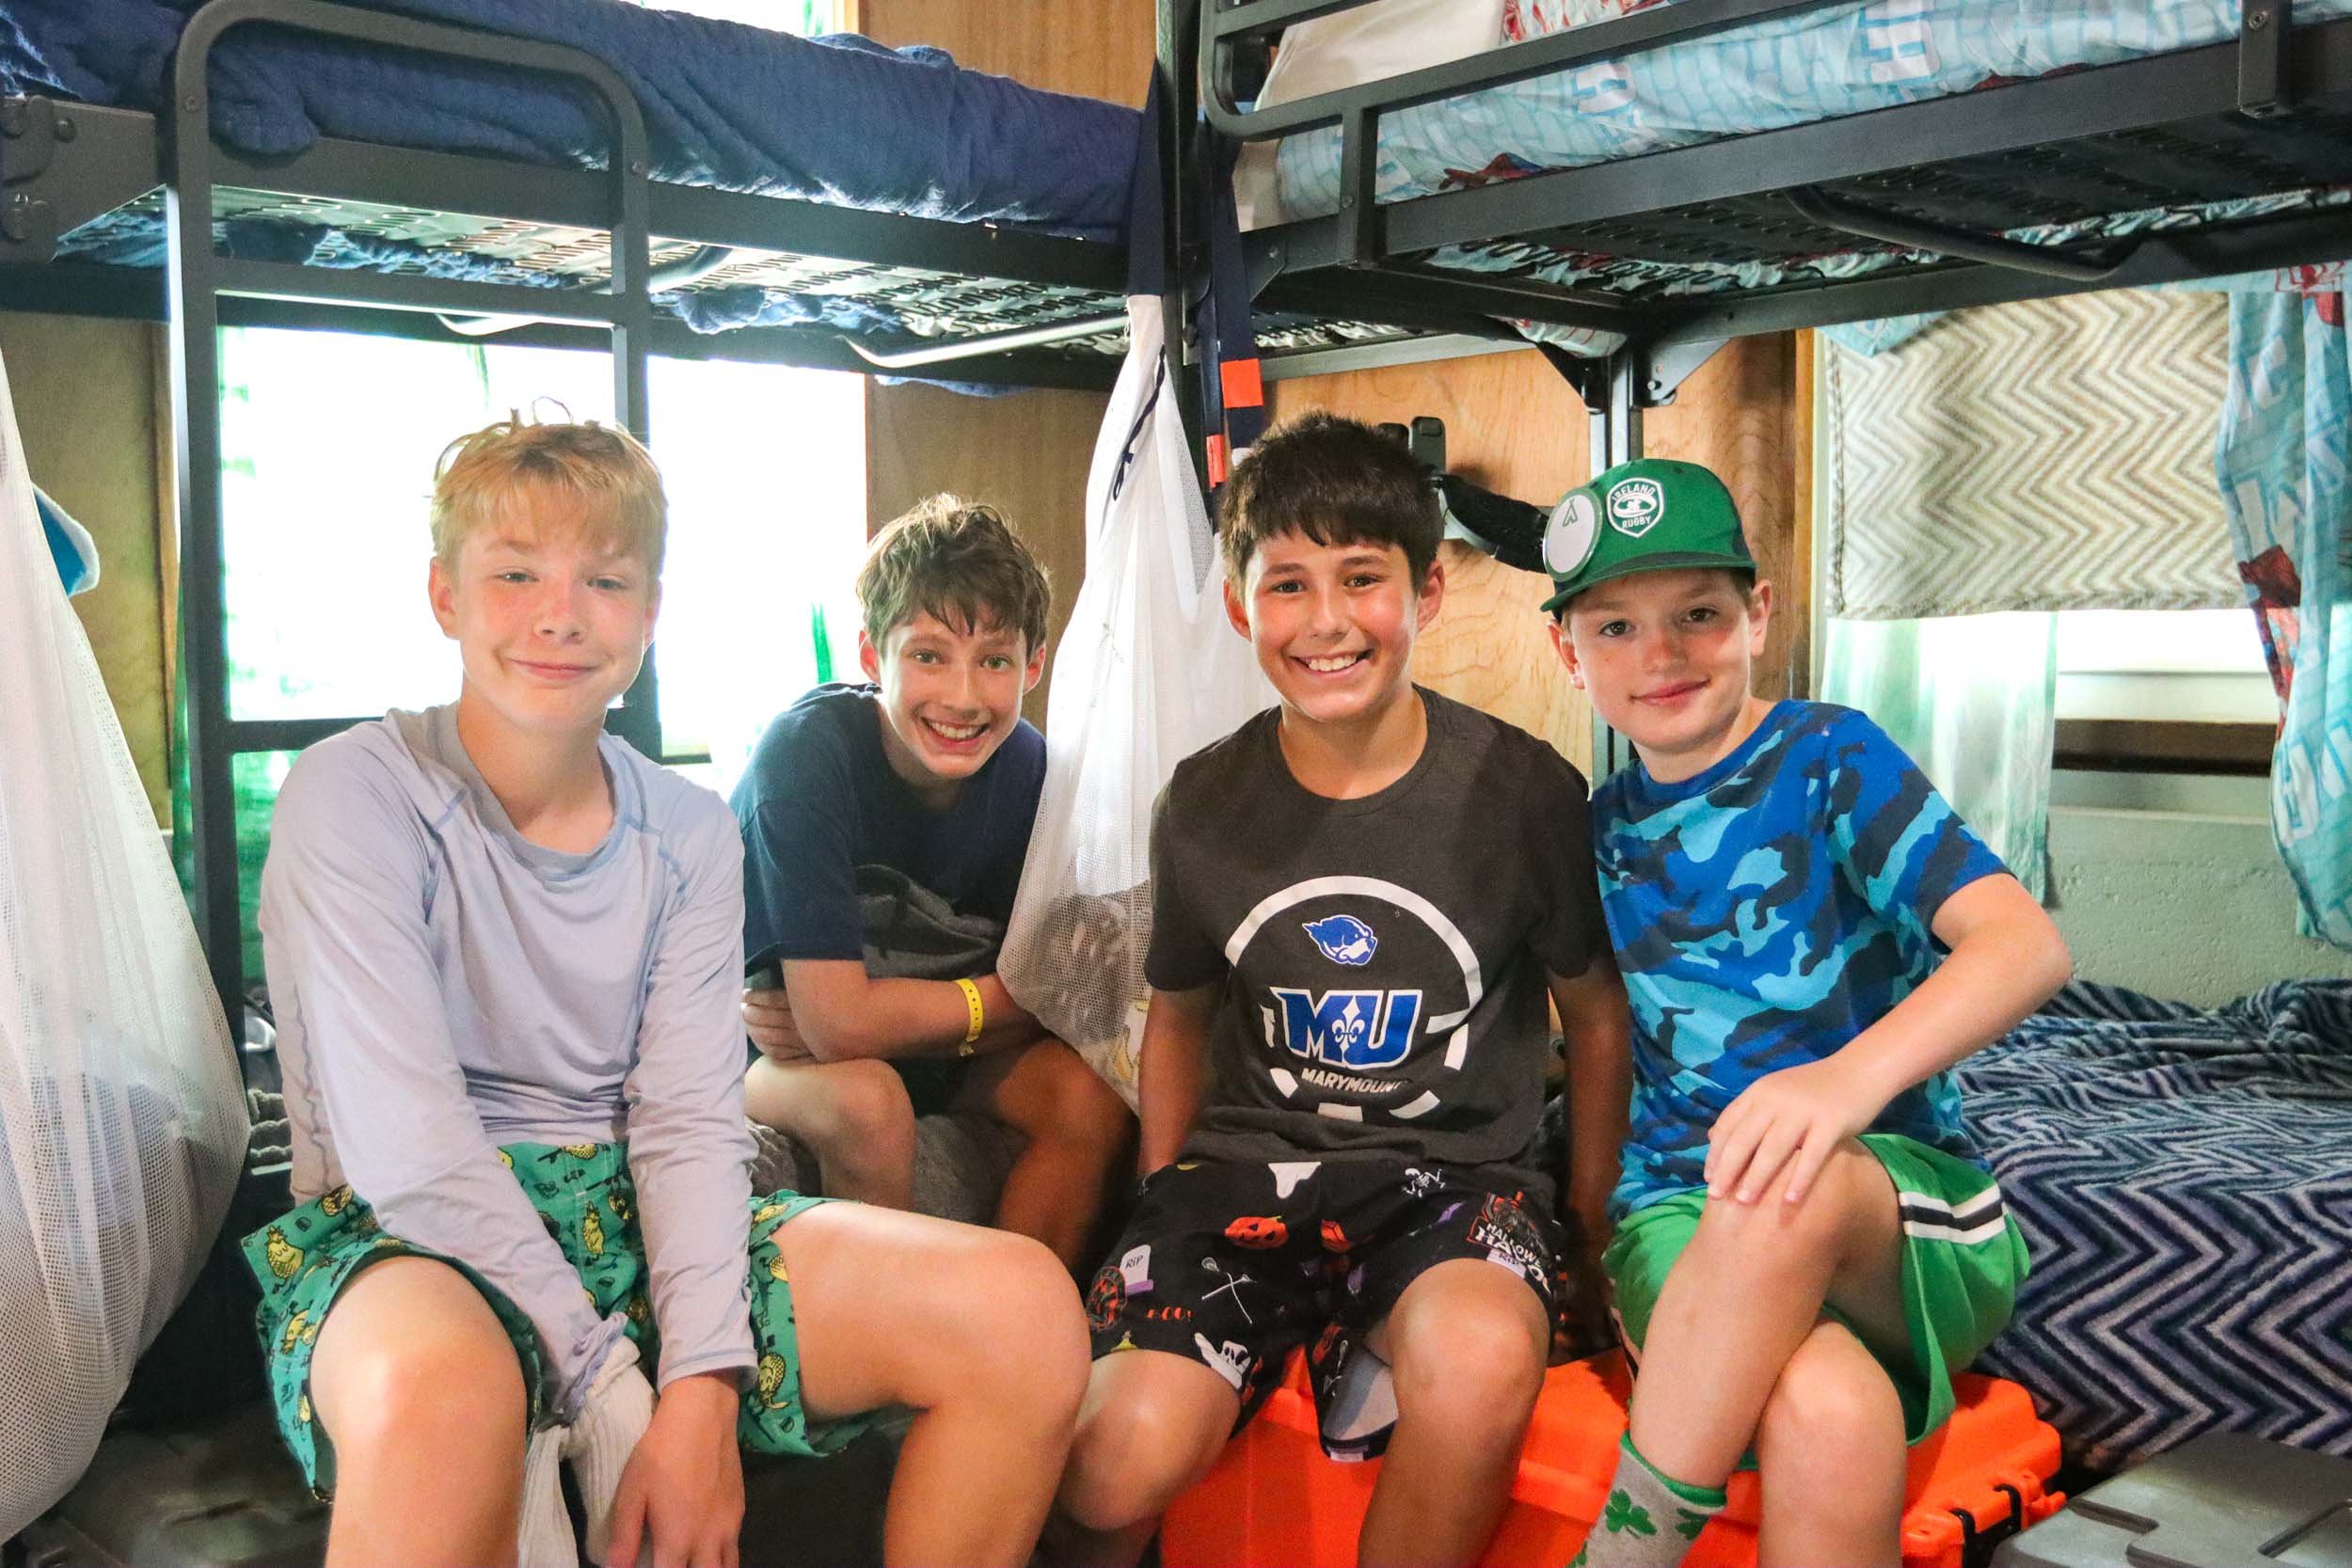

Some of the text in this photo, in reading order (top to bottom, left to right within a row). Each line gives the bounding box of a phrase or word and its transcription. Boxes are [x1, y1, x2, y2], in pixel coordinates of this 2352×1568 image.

[1612, 483, 1656, 501] IRELAND
[1622, 515, 1652, 529] RUGBY
[1269, 986, 1423, 1069] MU
[1486, 1223, 1544, 1268] HALLOWE
